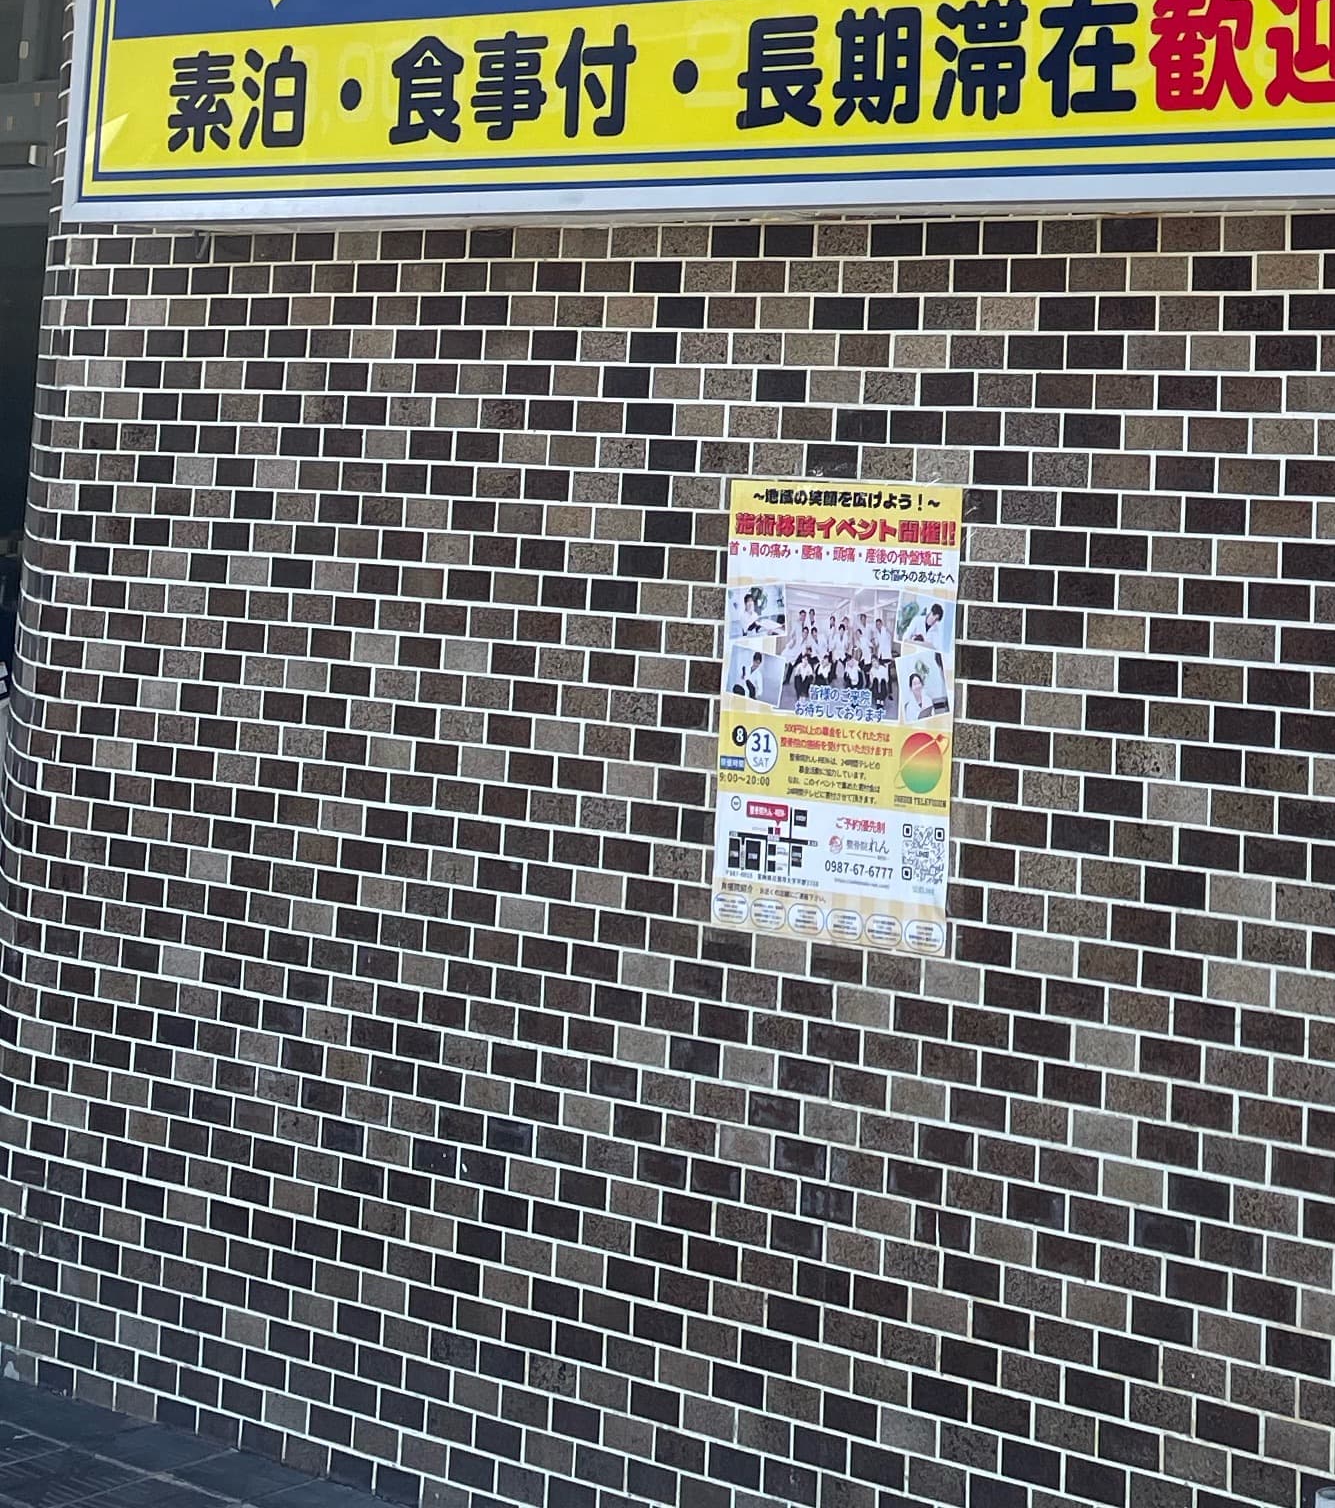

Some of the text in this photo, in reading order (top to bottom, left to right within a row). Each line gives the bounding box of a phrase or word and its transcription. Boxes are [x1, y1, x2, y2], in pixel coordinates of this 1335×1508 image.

[794, 702, 885, 723] お待ちしております
[735, 728, 745, 743] 8
[751, 733, 772, 754] 31
[752, 757, 769, 768] SAT
[824, 859, 894, 880] 0987-67-6777
